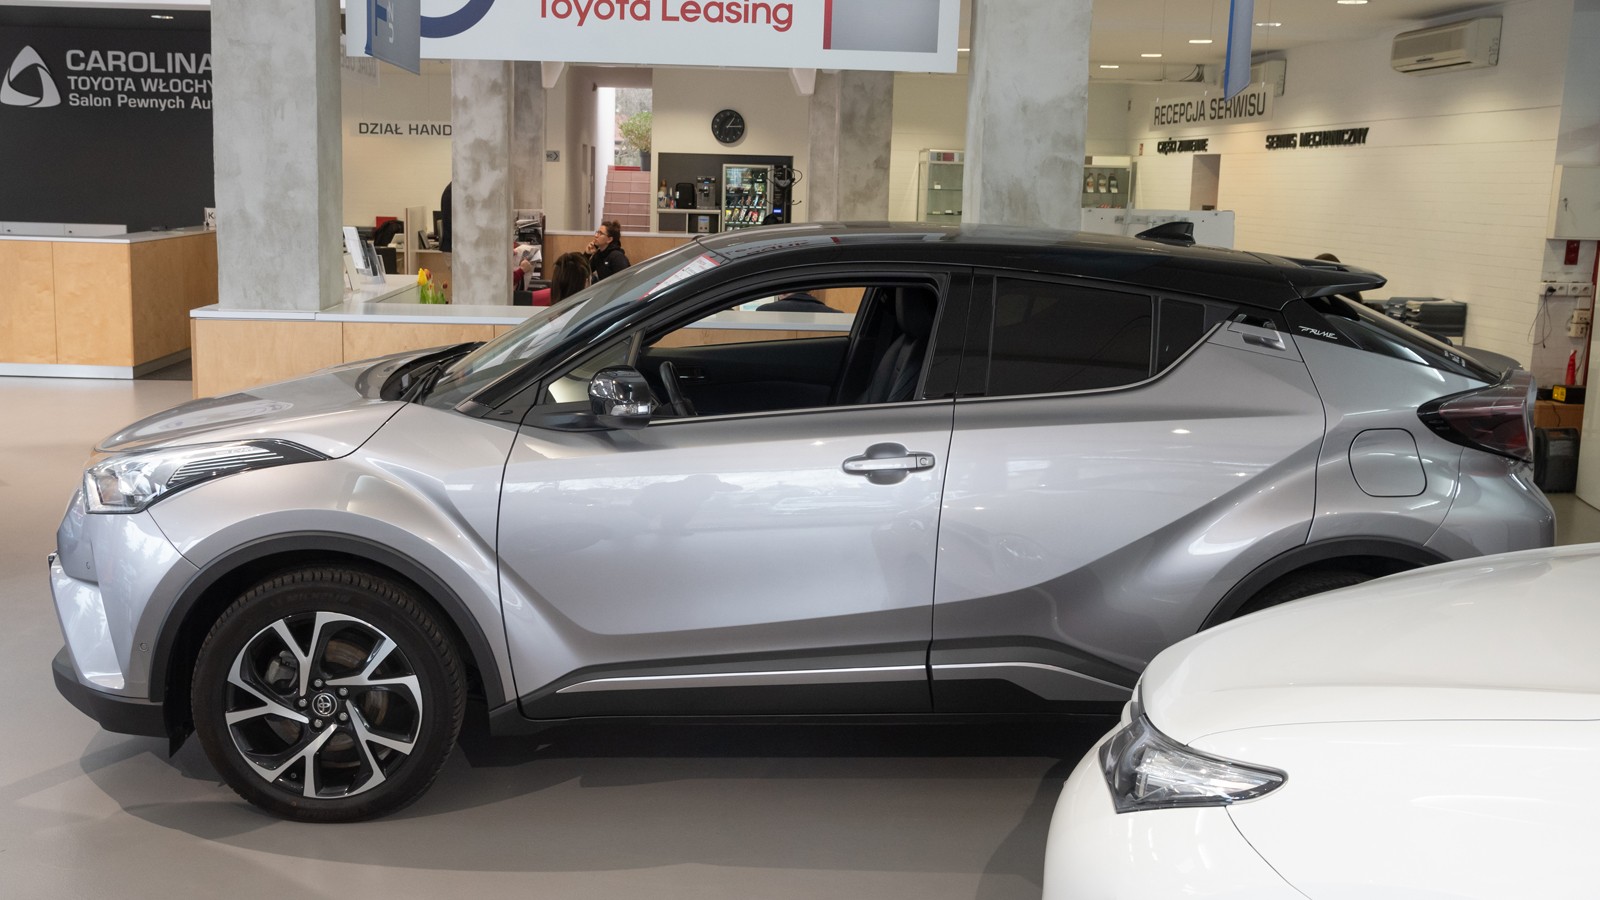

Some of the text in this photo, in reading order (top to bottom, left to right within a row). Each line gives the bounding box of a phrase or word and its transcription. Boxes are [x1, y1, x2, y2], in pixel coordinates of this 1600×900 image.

[661, 0, 794, 33] Leasing
[65, 49, 213, 75] CAROLINA
[67, 75, 137, 92] TOYOTA
[68, 93, 213, 112] Salon Pewnych Au
[1154, 92, 1267, 126] RECEPCJA SERWISU
[358, 122, 404, 135] DZIAŁ
